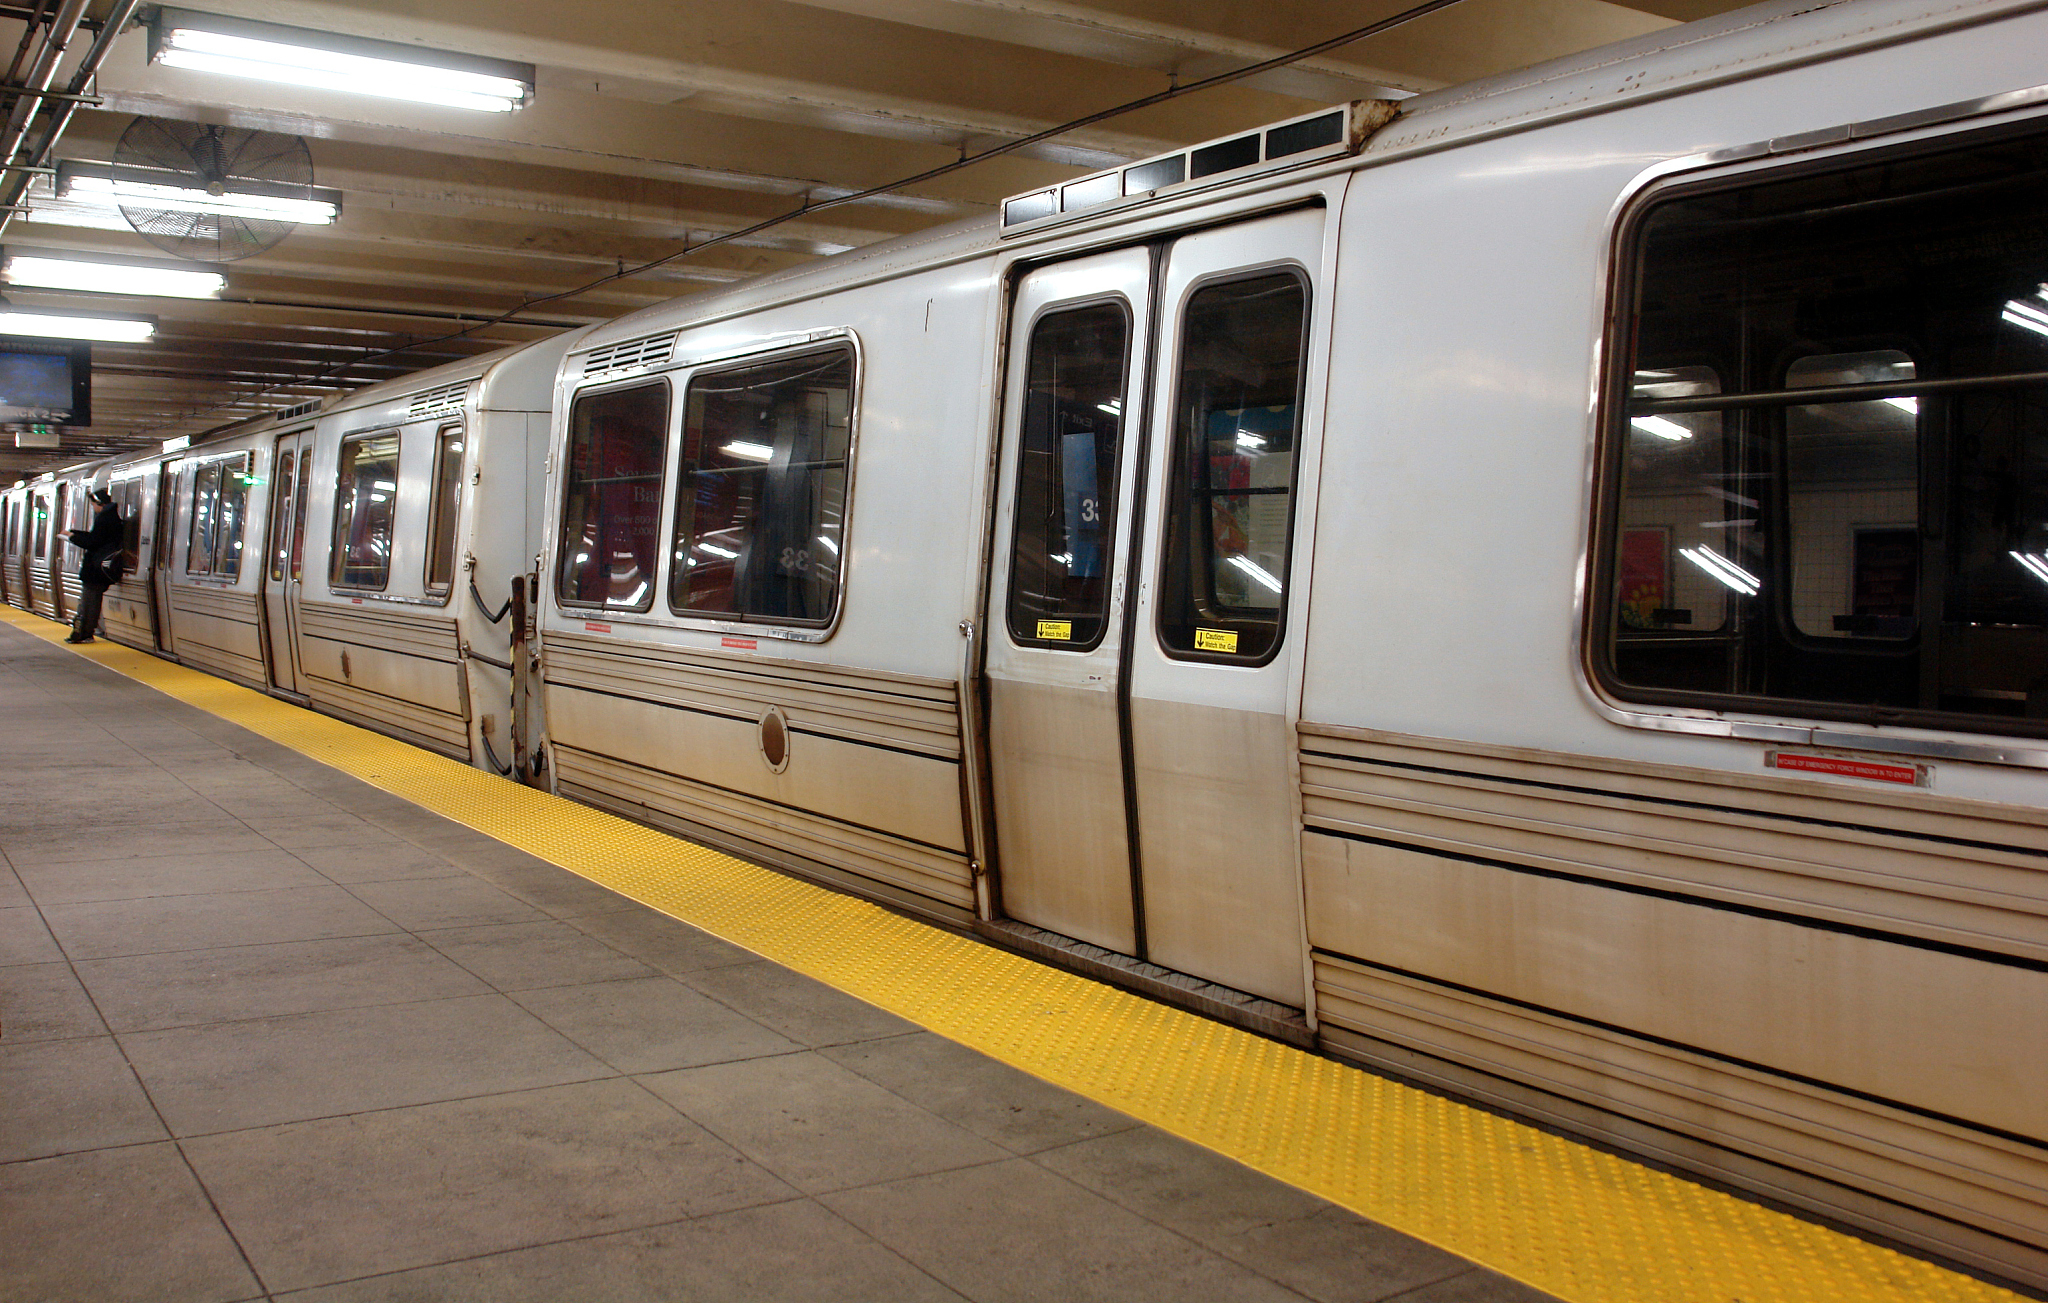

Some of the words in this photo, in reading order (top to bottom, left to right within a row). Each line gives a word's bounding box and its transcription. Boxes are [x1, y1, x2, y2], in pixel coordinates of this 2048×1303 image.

[41, 409, 50, 418] 2
[1227, 643, 1236, 651] Gap
[1805, 760, 1836, 770] EMERGENCY
[1837, 764, 1855, 773] FORCE
[1856, 766, 1878, 775] WINDOW
[1894, 771, 1912, 780] ENTER
